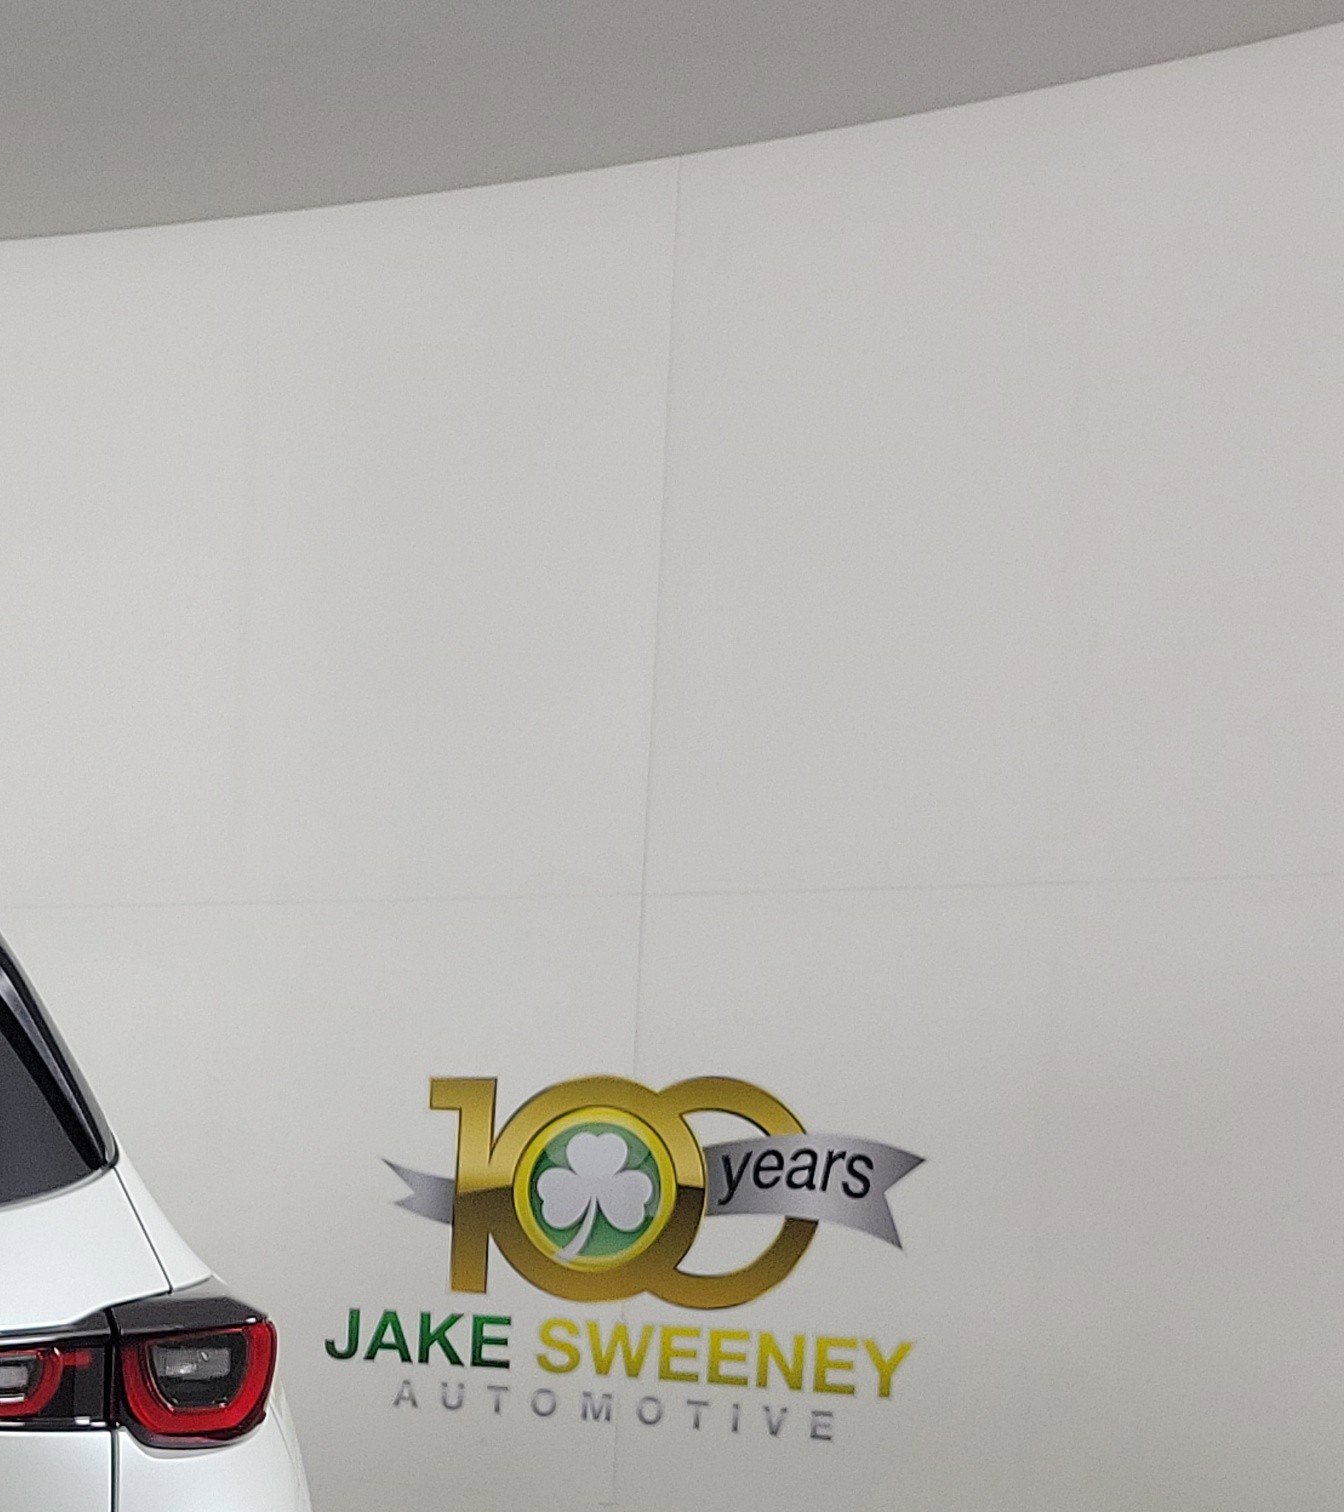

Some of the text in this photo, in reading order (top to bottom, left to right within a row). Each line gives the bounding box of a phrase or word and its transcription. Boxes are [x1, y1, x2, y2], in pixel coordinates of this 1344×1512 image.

[429, 1075, 873, 1310] 100 years
[324, 1308, 913, 1399] JAKE SWEENEY
[393, 1379, 834, 1442] AUTOMOTIVE
